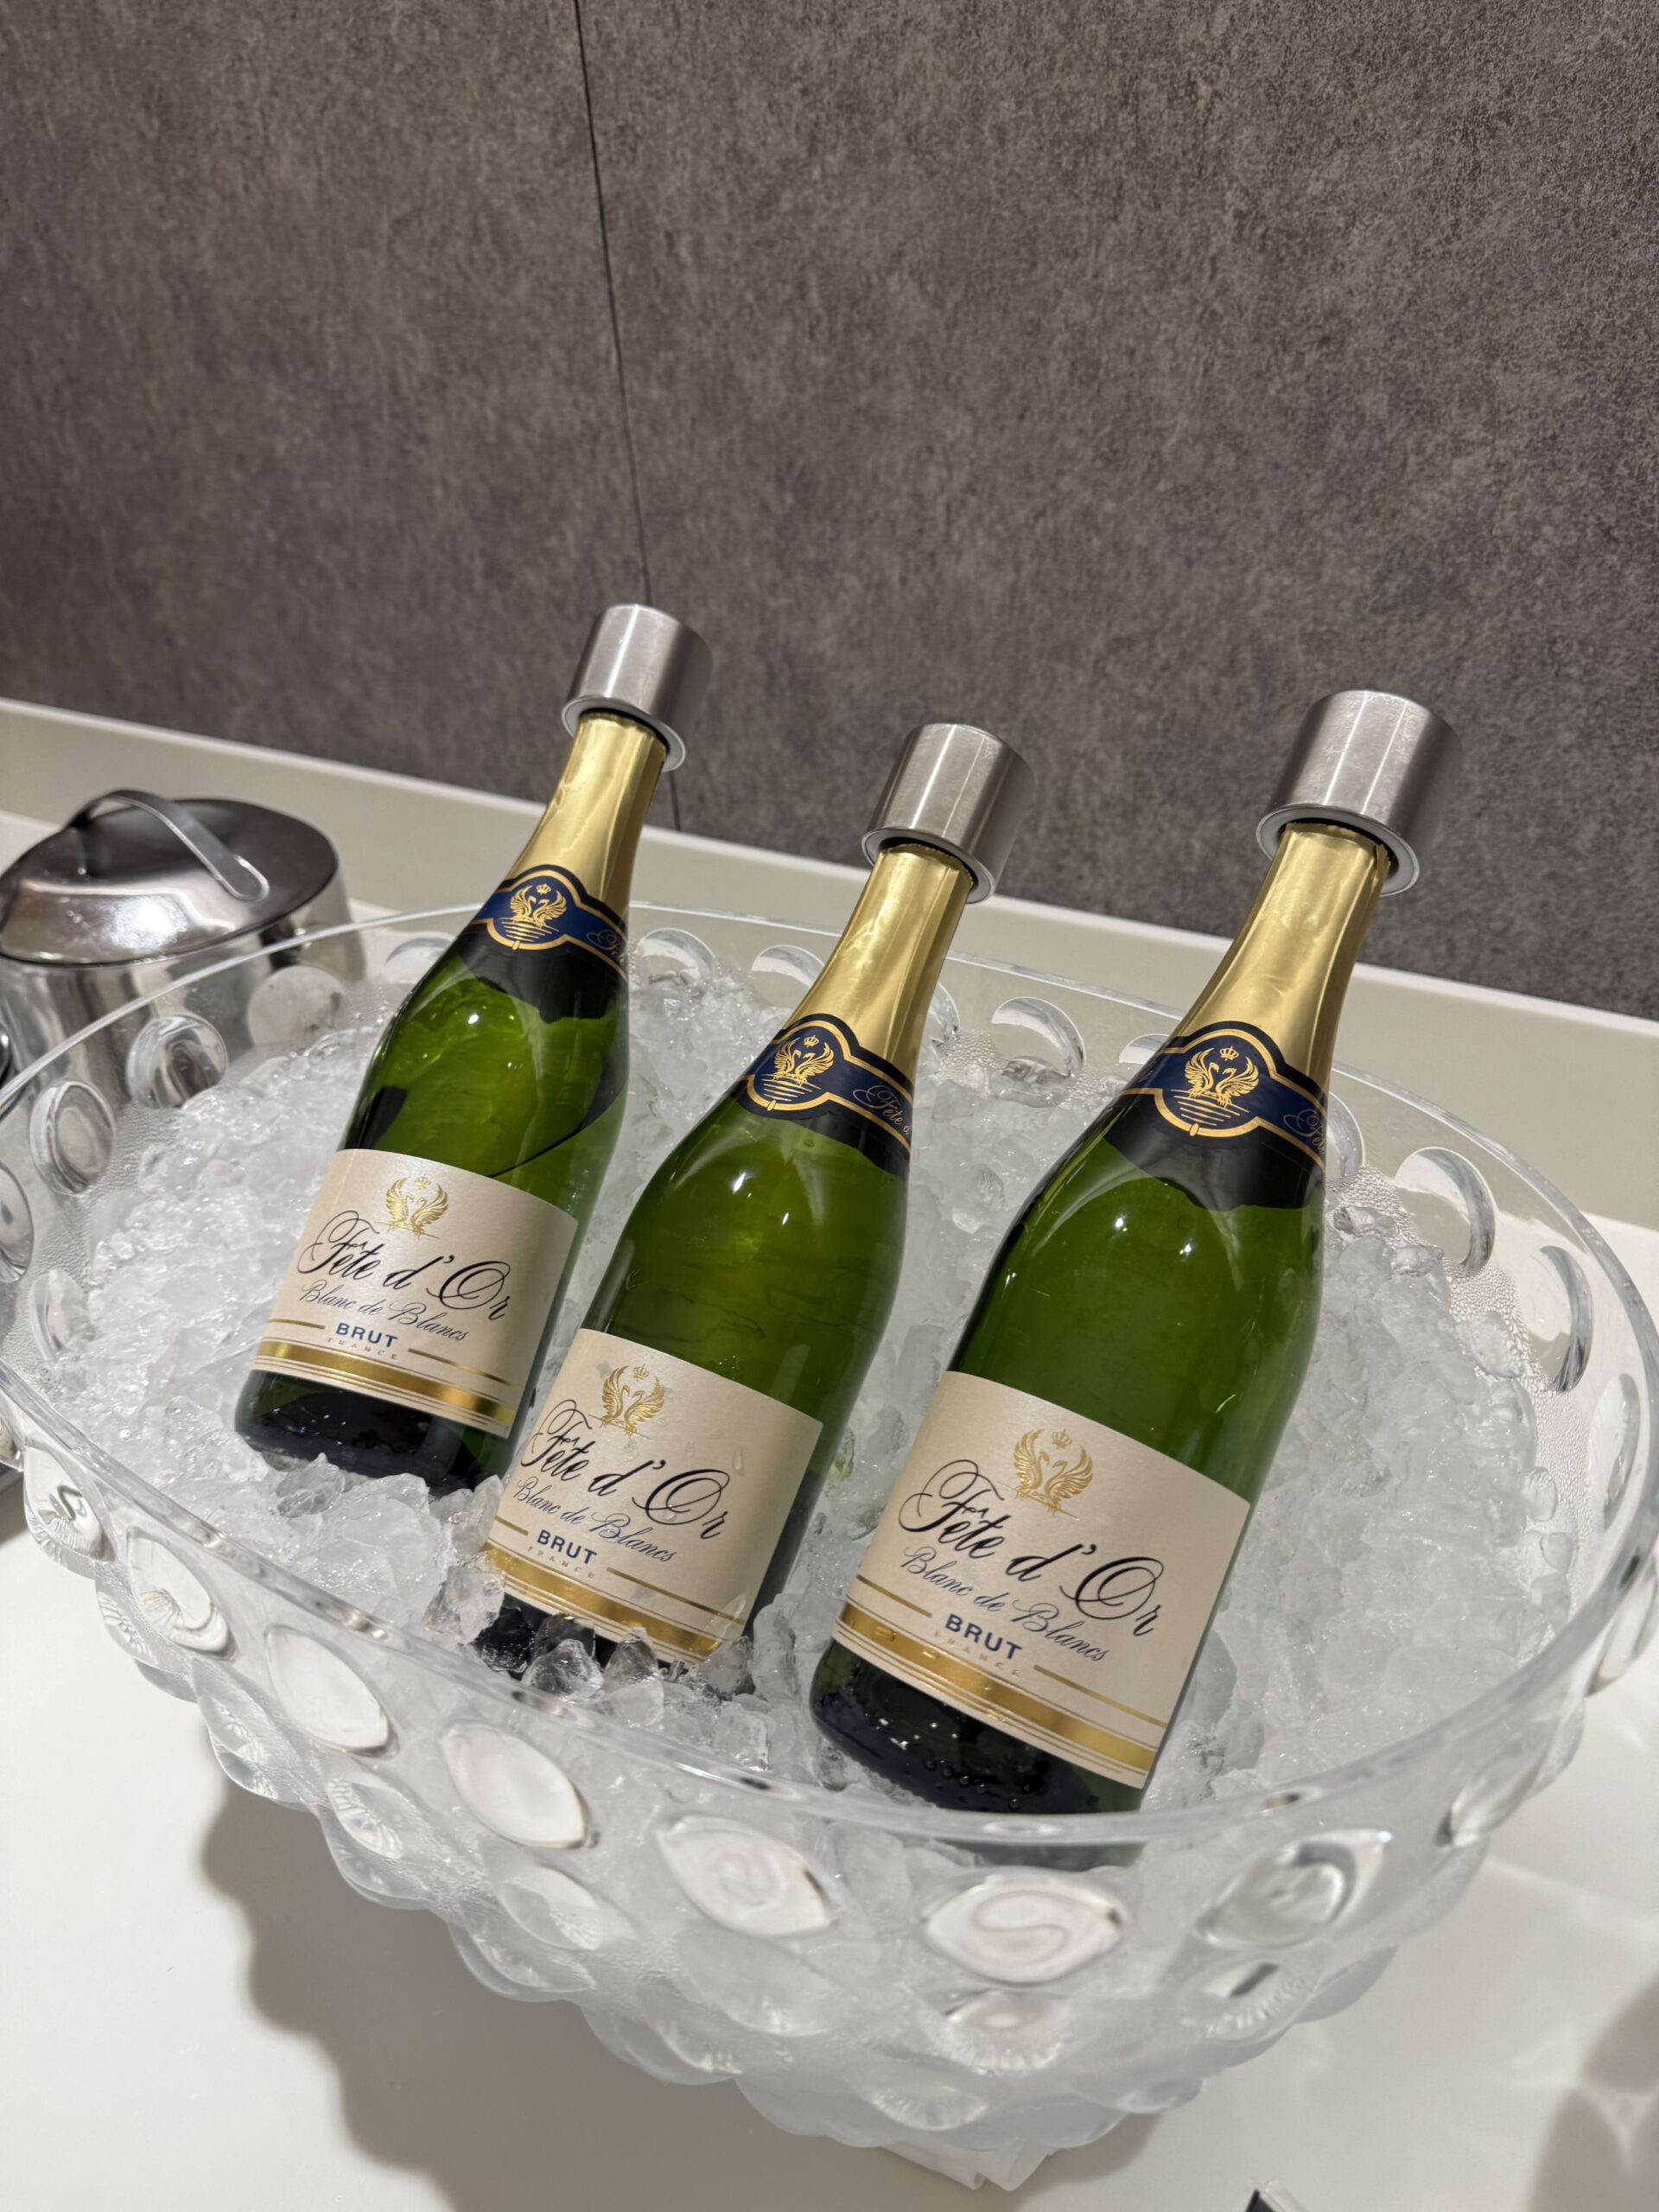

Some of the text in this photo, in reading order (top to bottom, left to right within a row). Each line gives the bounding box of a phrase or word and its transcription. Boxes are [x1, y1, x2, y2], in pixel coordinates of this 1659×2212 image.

[297, 1211, 384, 1281] Fête
[300, 1280, 470, 1341] Blanc de Blancs
[336, 1323, 397, 1347] BRUT
[327, 1337, 397, 1359] FRANCE
[520, 1399, 595, 1481] Fête
[513, 1476, 677, 1562] Blanc de Blancs
[899, 1459, 1011, 1558] Fête
[528, 1546, 594, 1579] FRANCE
[537, 1529, 597, 1564] BRUT
[900, 1546, 1110, 1662] Blanc de Blancs
[945, 1613, 1022, 1660] BRUT
